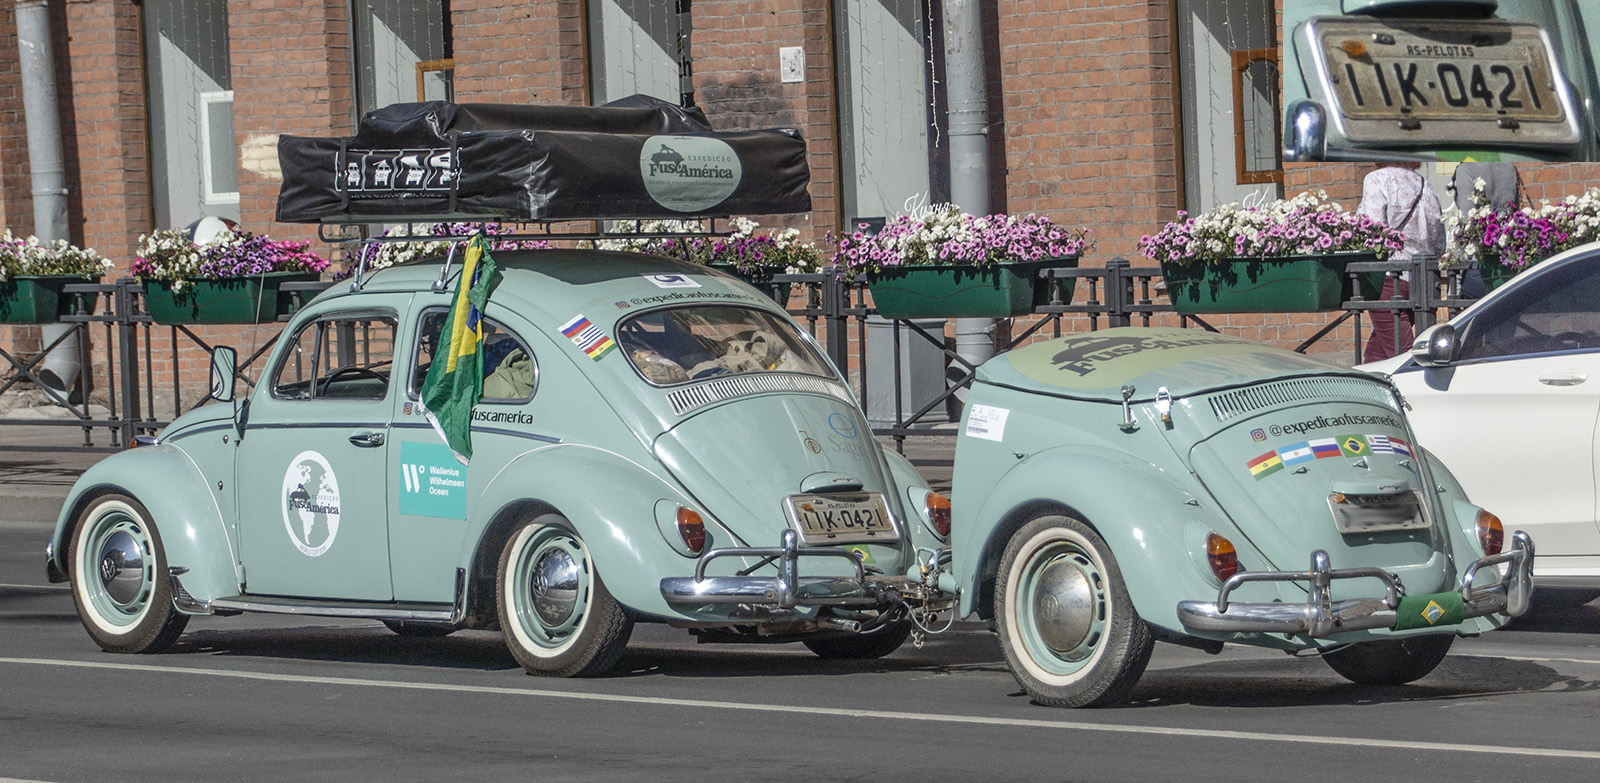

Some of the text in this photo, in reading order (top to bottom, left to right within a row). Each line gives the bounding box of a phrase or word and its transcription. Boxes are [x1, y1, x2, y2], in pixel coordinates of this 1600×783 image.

[1406, 45, 1474, 57] RS-PELOTAS
[687, 155, 732, 163] EXPEDIÇÃO
[648, 163, 734, 179] FuscAmérica
[470, 407, 534, 425] fuscamerica
[429, 465, 460, 477] Wallenius
[429, 476, 465, 488] Wilhelmsen
[428, 486, 449, 496] Ocean
[288, 500, 340, 515] FuscAmérica
